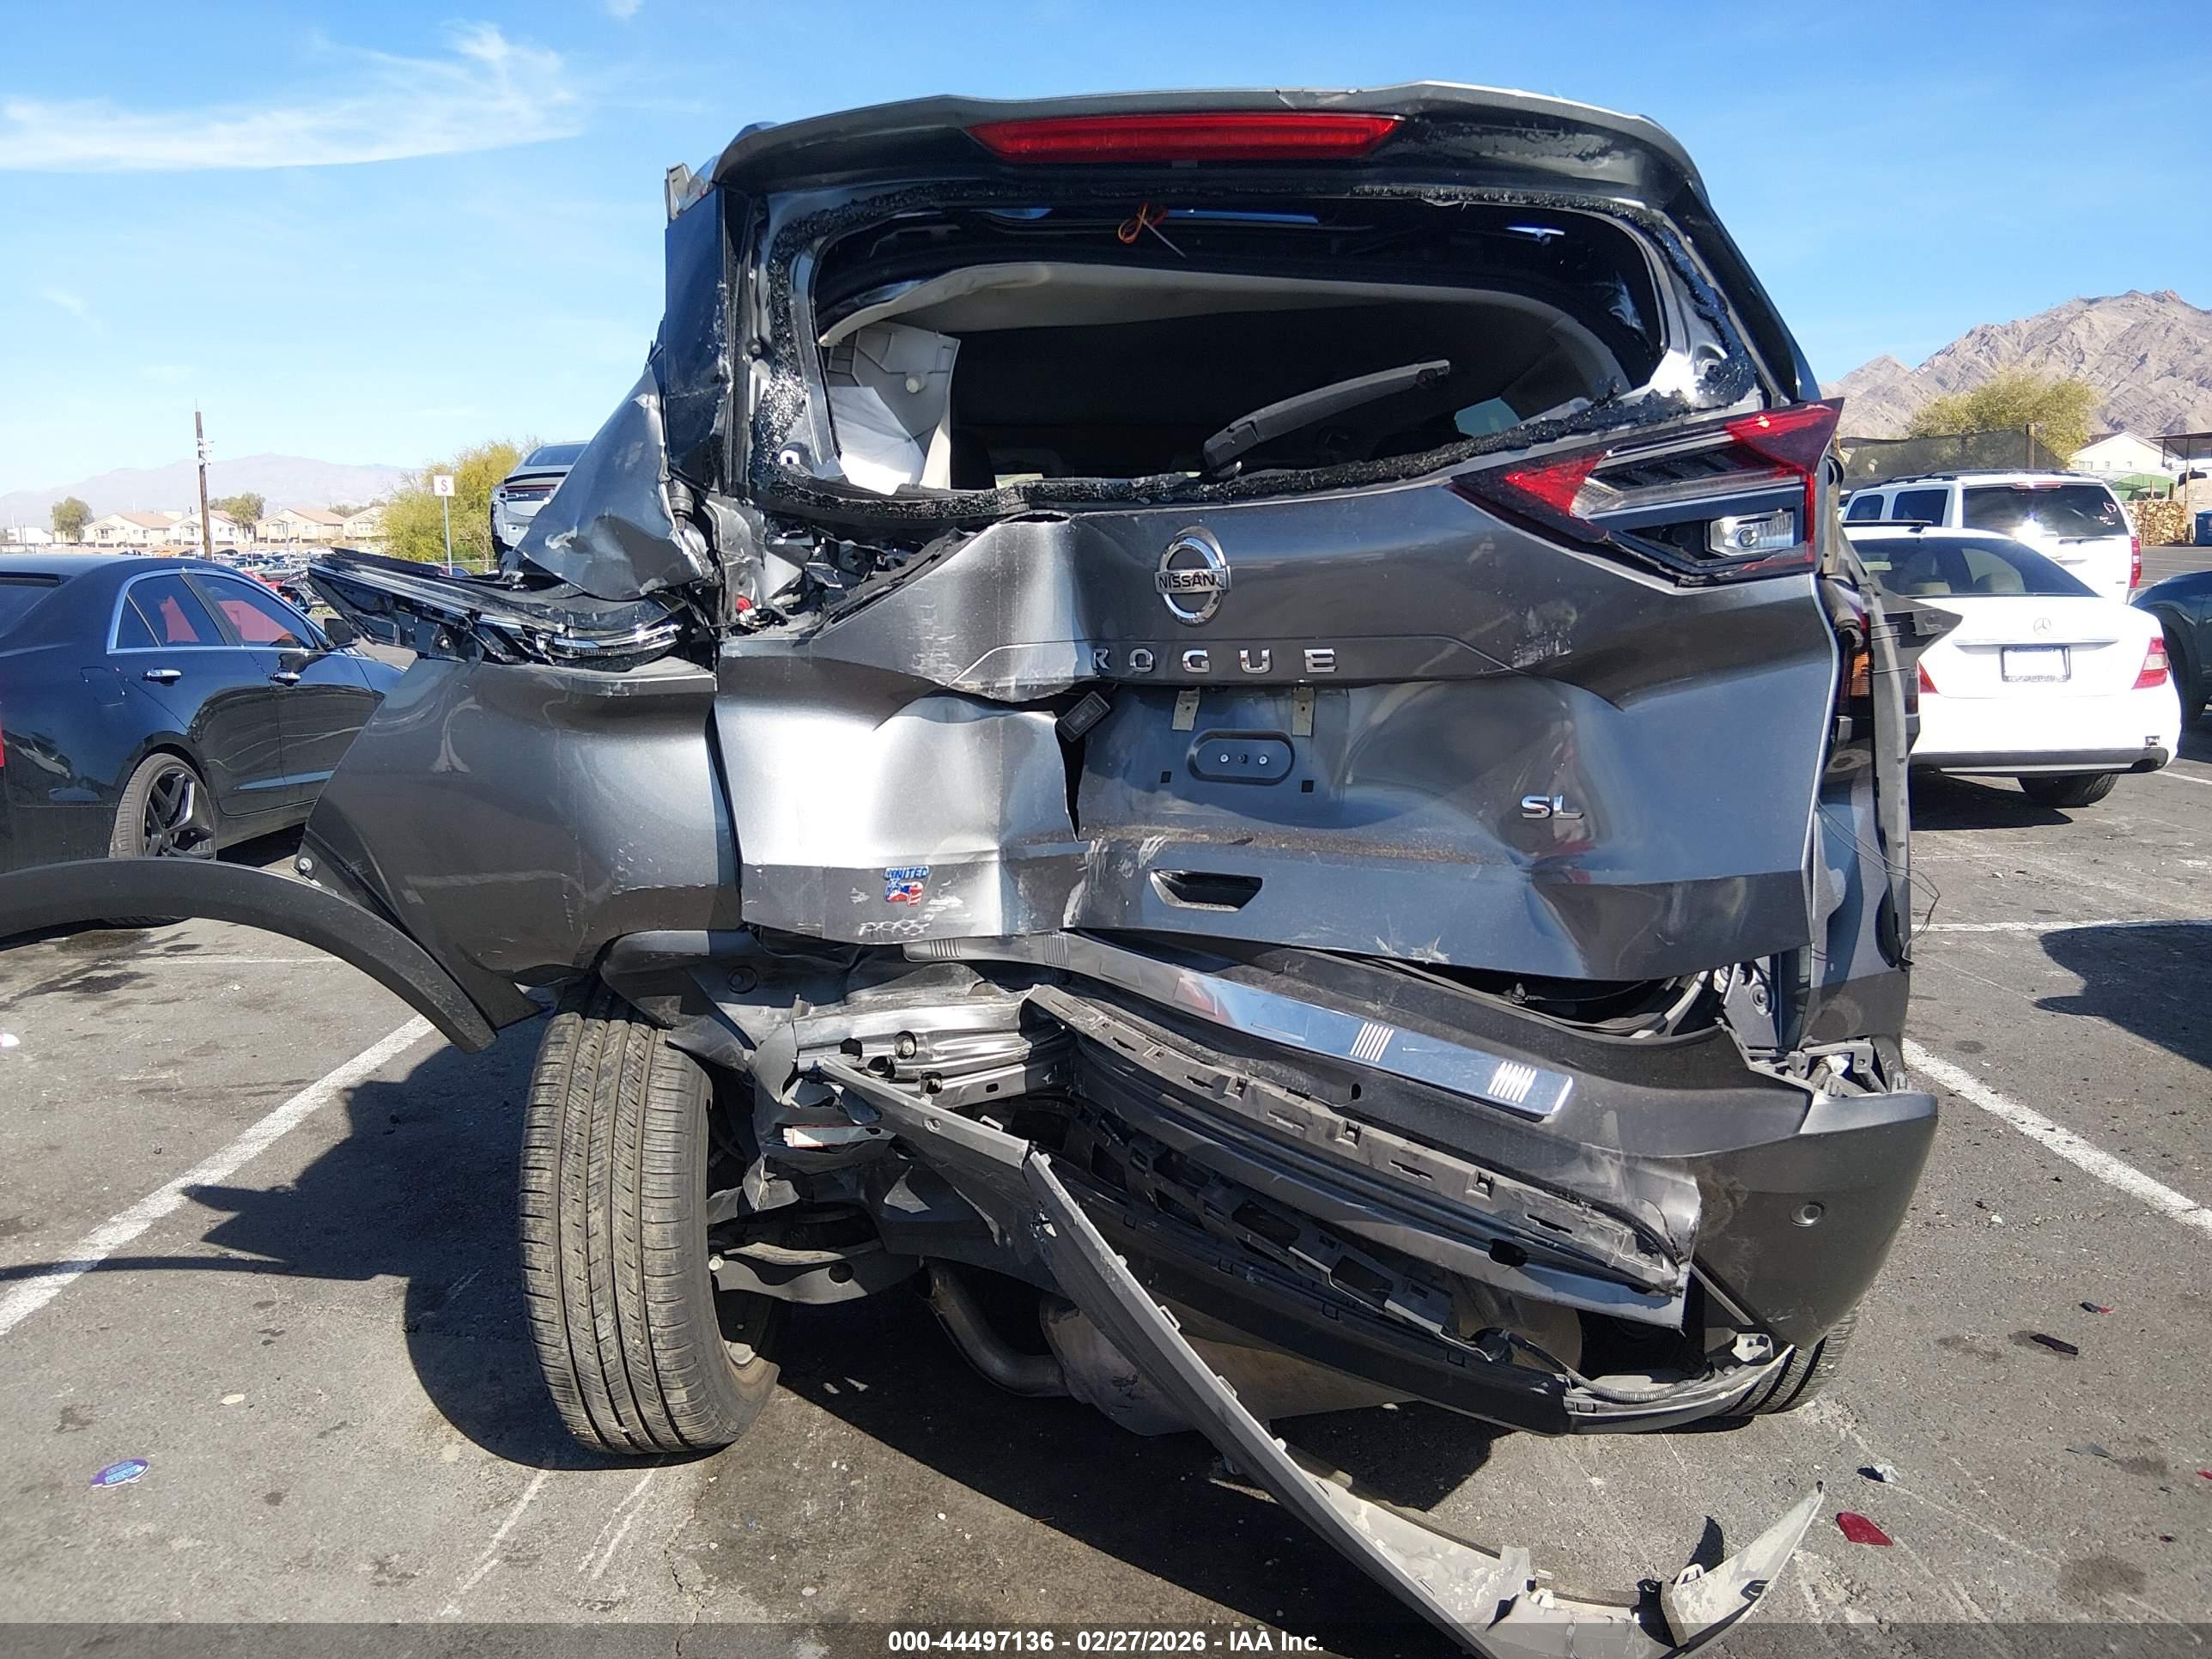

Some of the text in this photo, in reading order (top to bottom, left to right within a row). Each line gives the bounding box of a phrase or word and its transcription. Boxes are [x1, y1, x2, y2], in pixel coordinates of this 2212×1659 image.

[1159, 572, 1215, 590] NISSAN
[1092, 648, 1337, 674] ROGUE
[1521, 794, 1583, 819] SL
